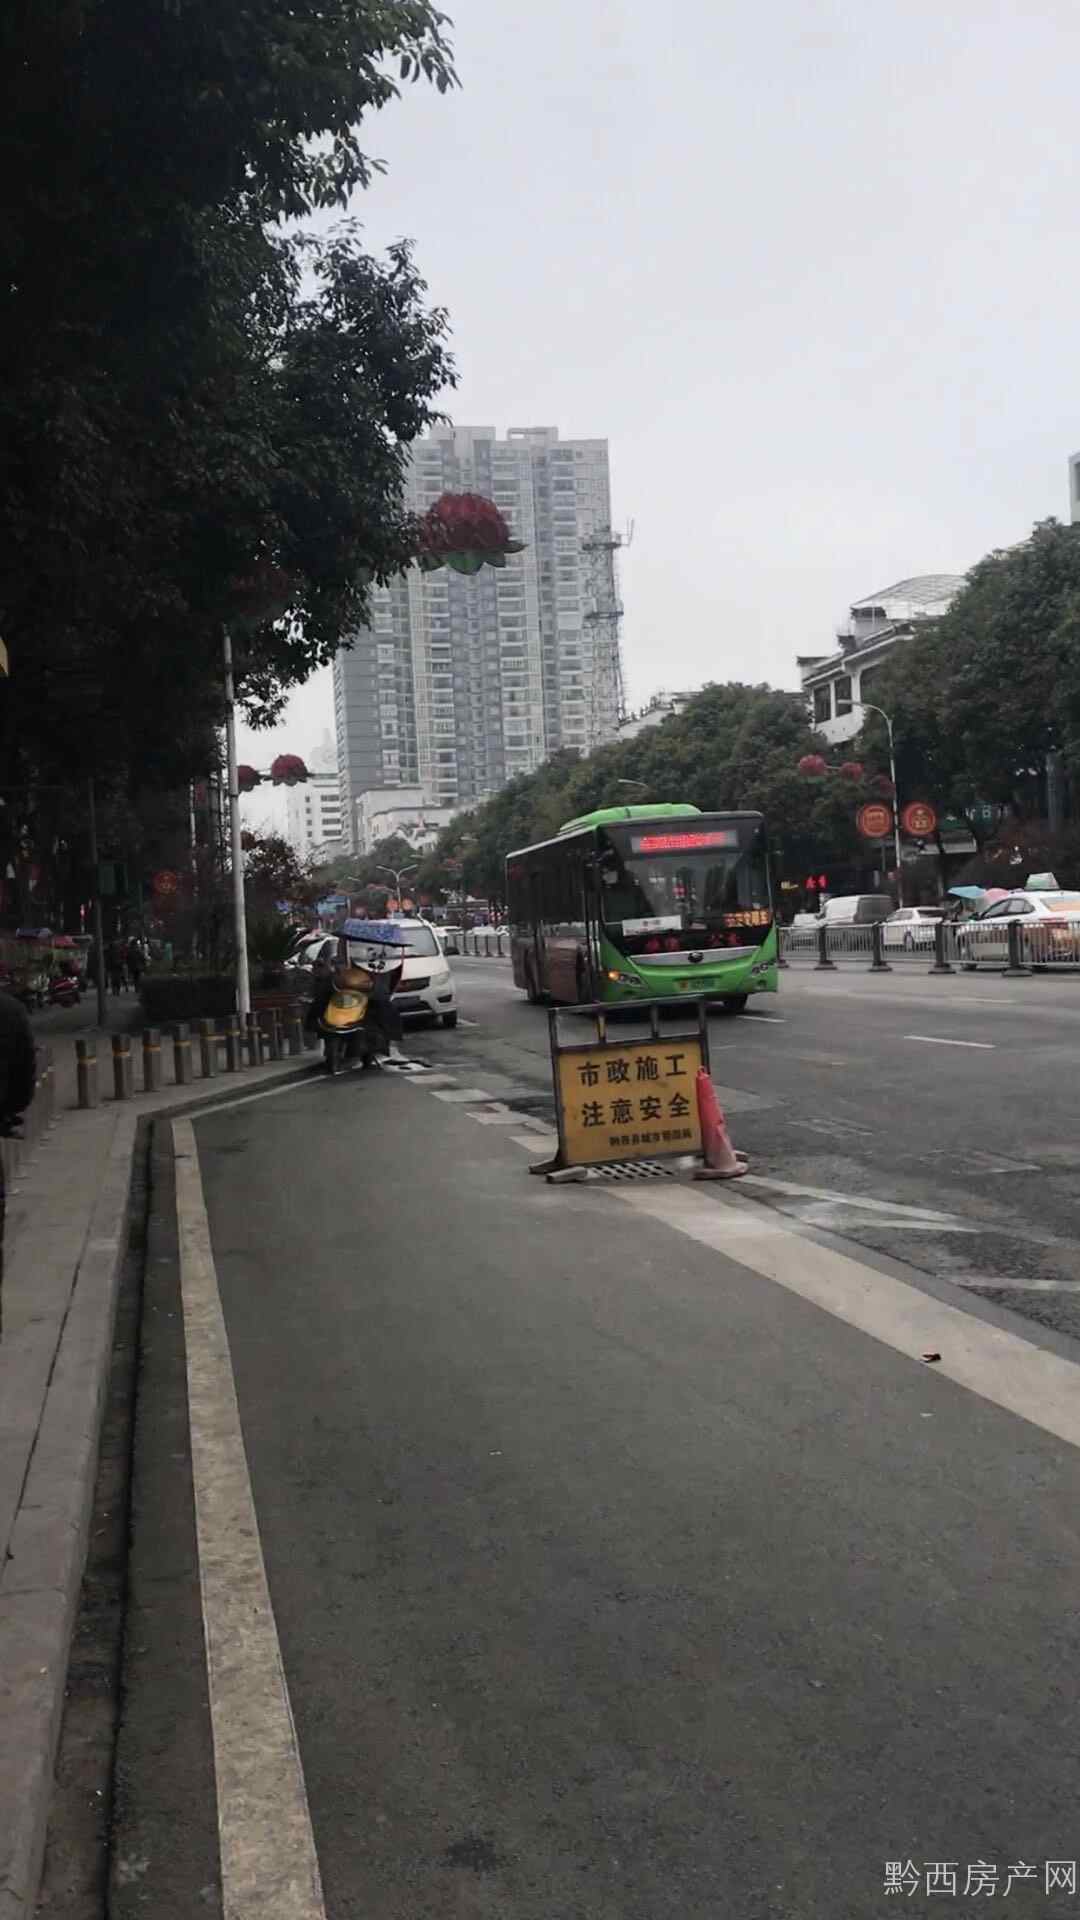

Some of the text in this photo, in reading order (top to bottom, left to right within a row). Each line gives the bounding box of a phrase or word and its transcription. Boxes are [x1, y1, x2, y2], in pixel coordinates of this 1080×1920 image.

[577, 1053, 687, 1087] 市政施工
[581, 1092, 690, 1128] 注意安全
